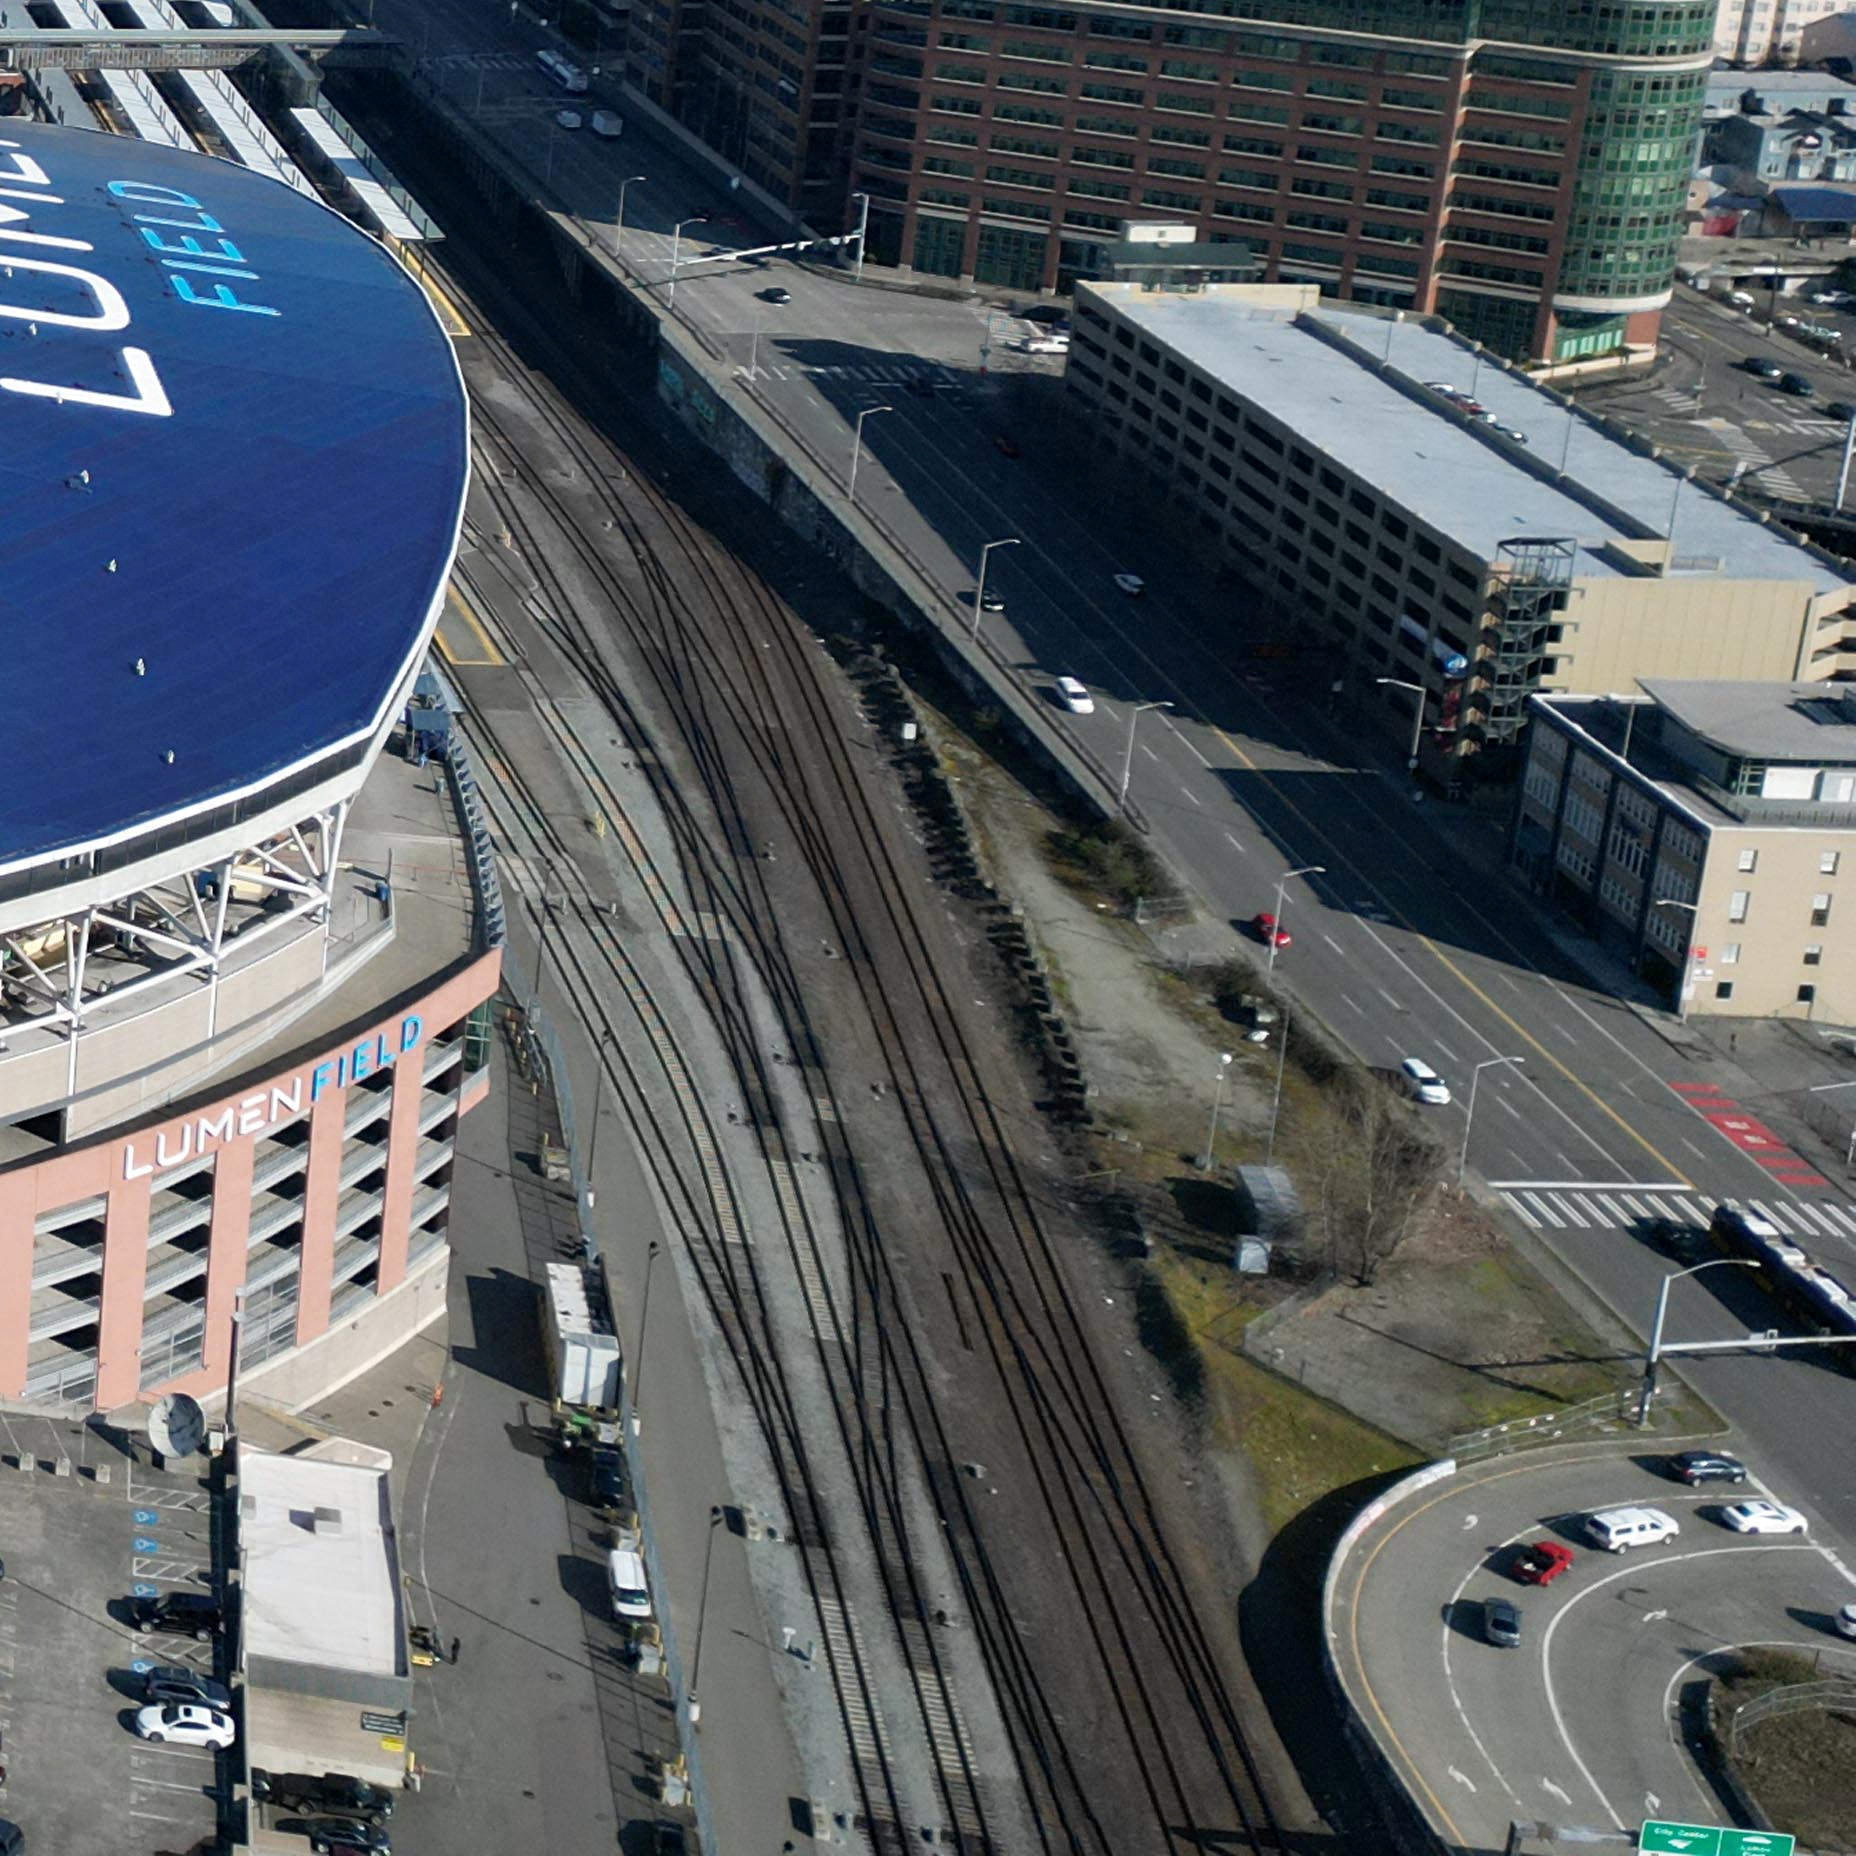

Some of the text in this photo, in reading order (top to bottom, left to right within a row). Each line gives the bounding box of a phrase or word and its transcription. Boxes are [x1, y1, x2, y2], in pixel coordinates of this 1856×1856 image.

[106, 180, 282, 316] FIELD
[123, 1014, 425, 1181] LUMEN FIELD
